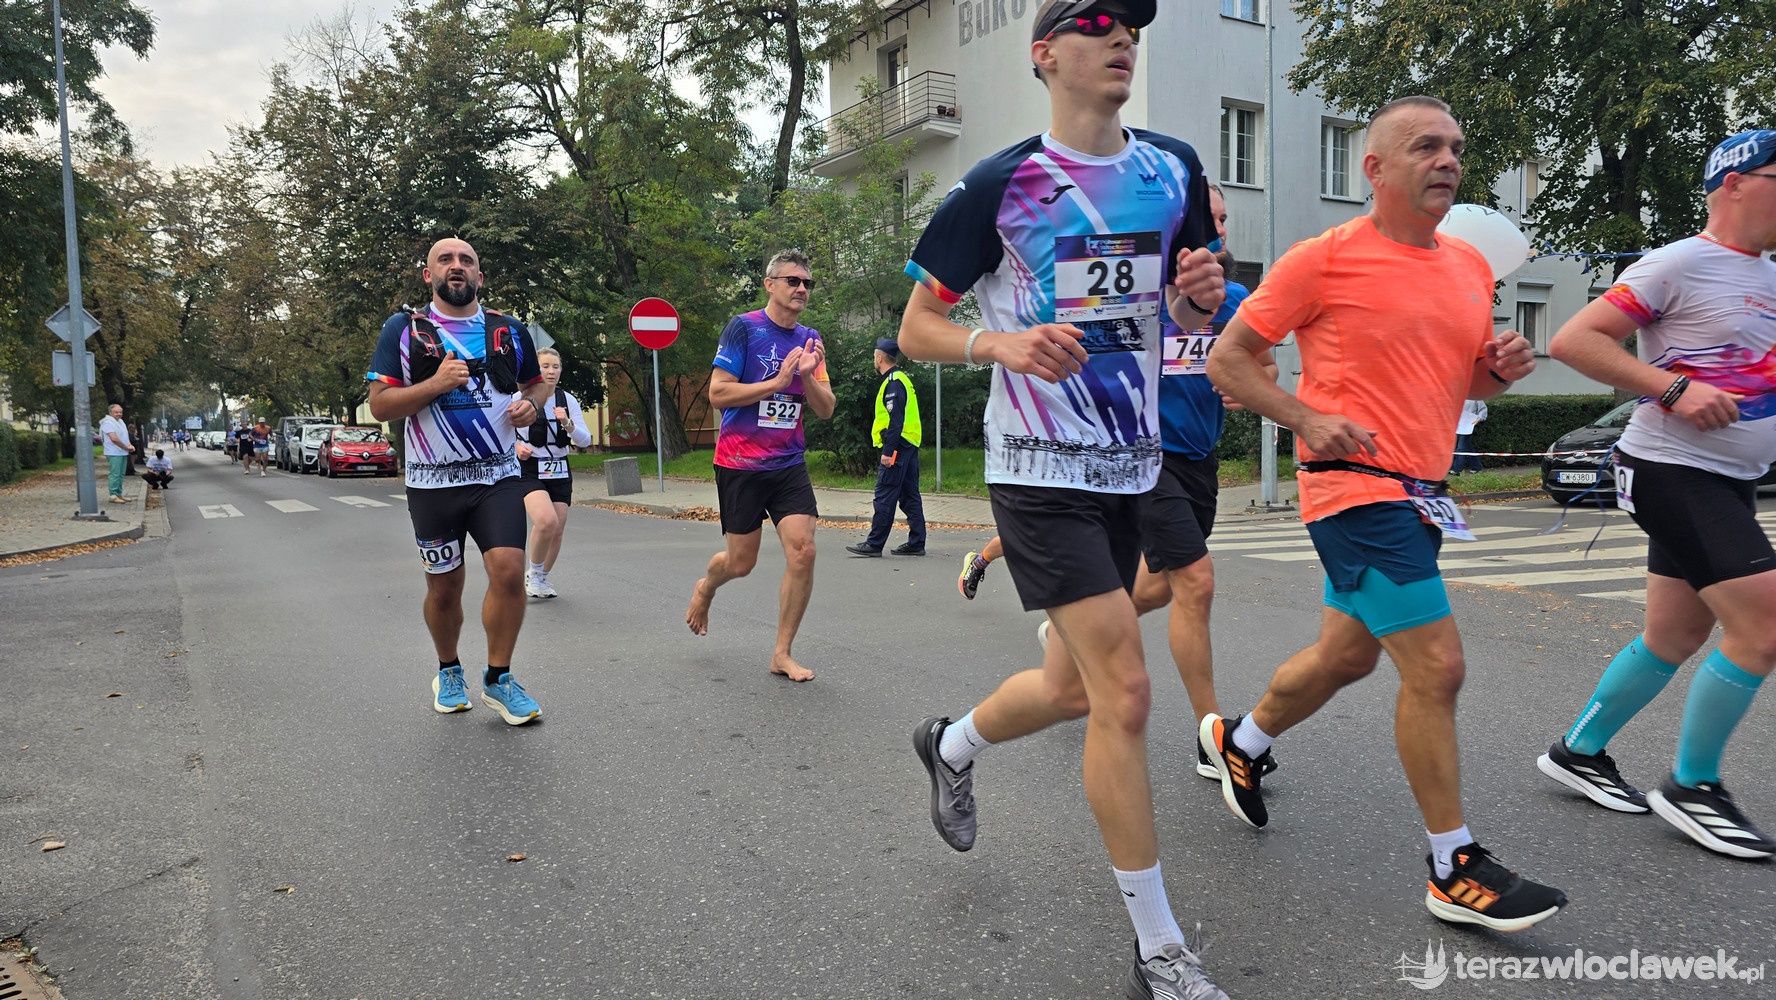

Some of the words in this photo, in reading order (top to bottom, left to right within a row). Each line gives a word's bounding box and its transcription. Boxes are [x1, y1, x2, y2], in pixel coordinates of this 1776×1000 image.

[959, 0, 1043, 47] Buko
[1087, 259, 1134, 296] 28
[766, 401, 797, 418] 522
[544, 461, 563, 473] 271
